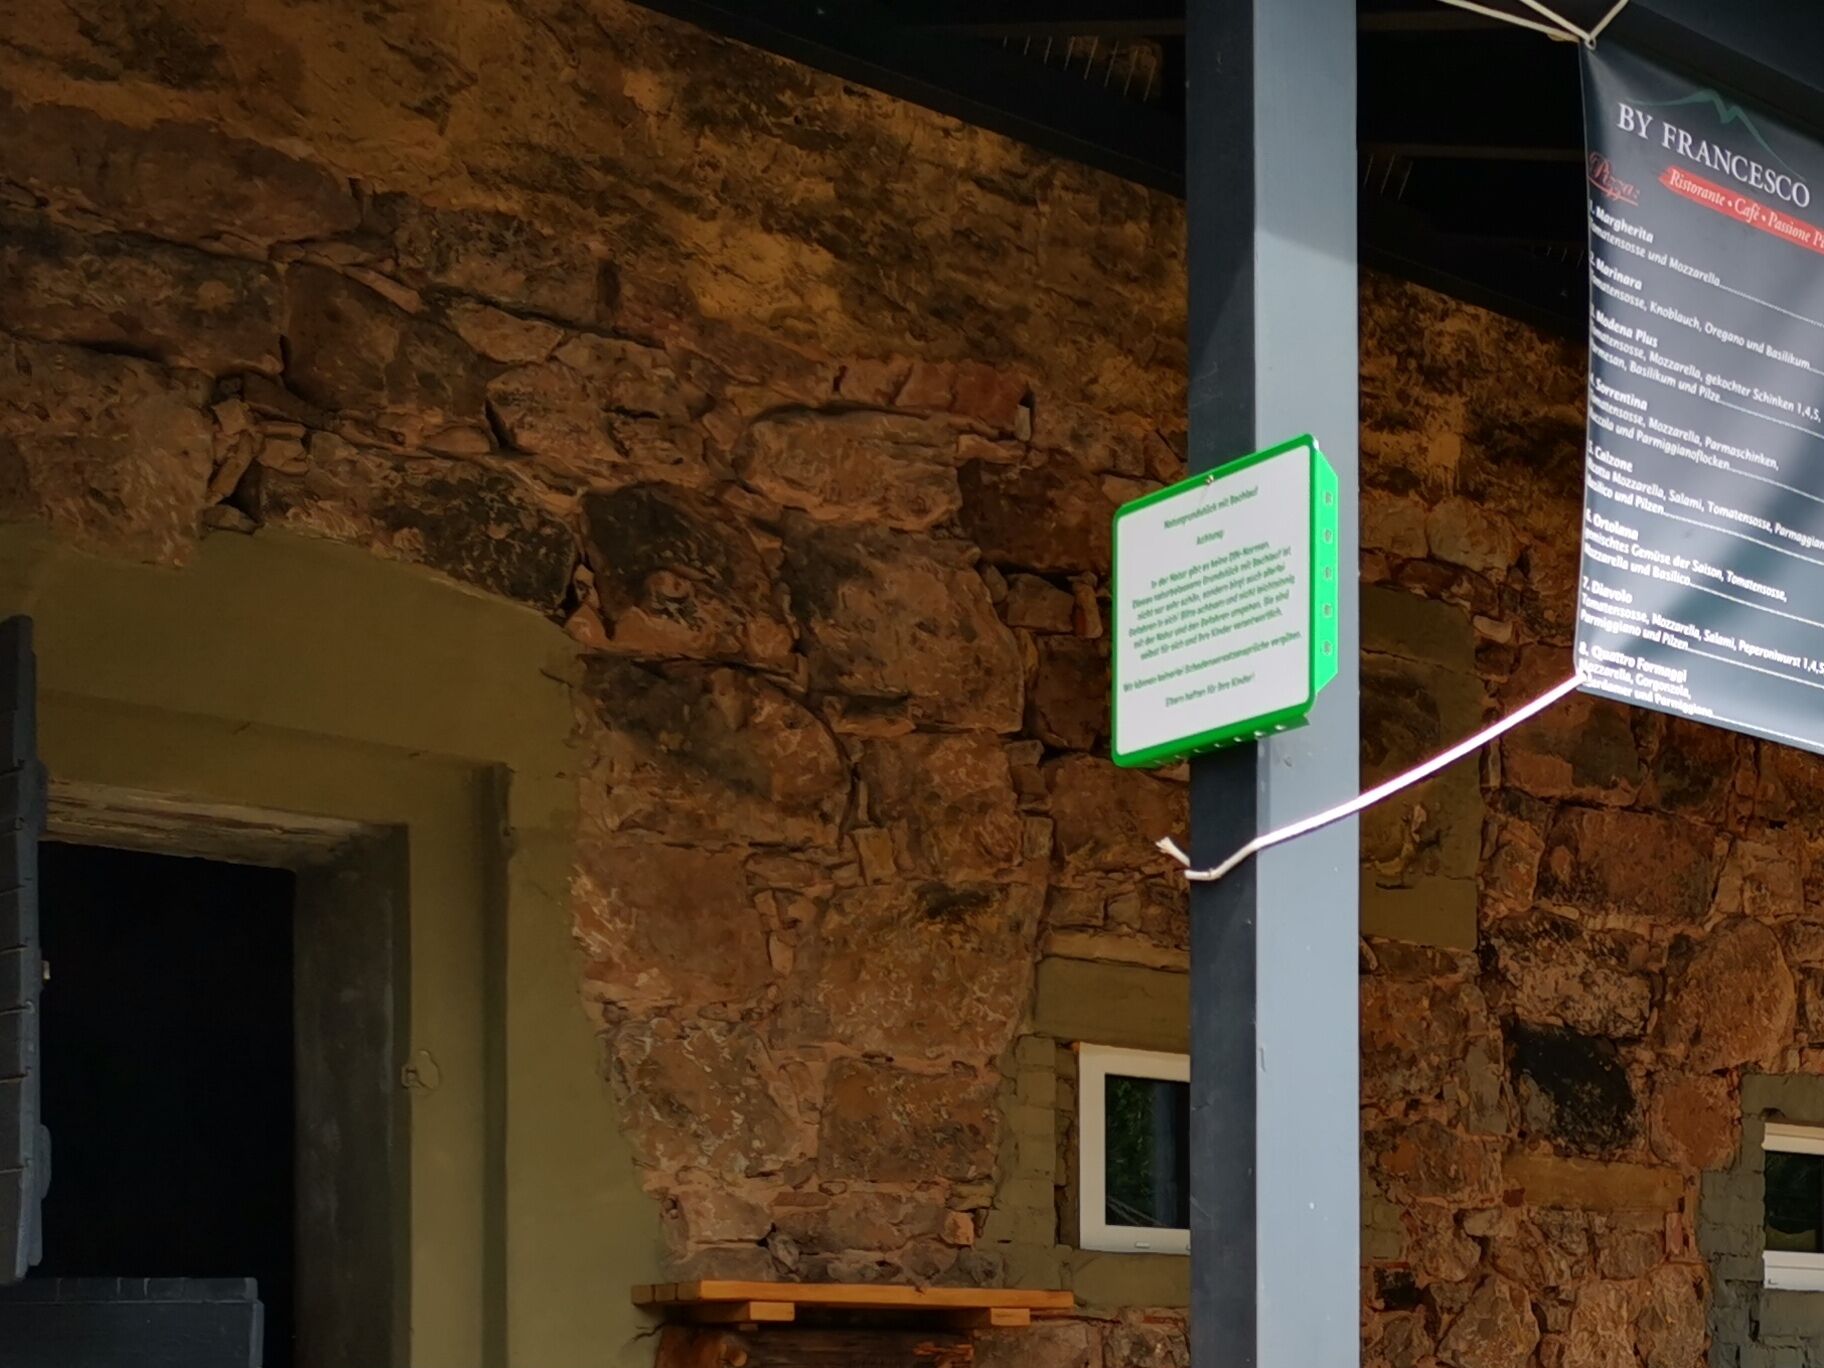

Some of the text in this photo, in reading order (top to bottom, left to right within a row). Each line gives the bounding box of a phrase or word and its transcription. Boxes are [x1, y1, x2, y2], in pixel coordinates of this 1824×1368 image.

[1617, 103, 1810, 208] BY FRANCESCO
[1669, 169, 1725, 206] Ristorante
[1768, 211, 1811, 243] Passione
[1597, 208, 1653, 243] Margherita
[1597, 259, 1642, 290] Marinara
[1648, 251, 1667, 265] und
[1669, 257, 1720, 286] Mozzarella
[1596, 311, 1657, 347] Modena Plus
[1650, 301, 1701, 331] Knoblauch,
[1705, 322, 1745, 345] Oregano
[1746, 340, 1764, 353] und
[1766, 346, 1810, 369] Basilikum
[1597, 380, 1647, 410] Sorrentina
[1630, 361, 1676, 386] Basilikum
[1678, 381, 1697, 394] und
[1699, 385, 1720, 403] Pilze
[1649, 351, 1820, 422] Mozzarella, gekochter Schinken 1,4,5,
[1615, 425, 1634, 439] und
[1649, 417, 1778, 469] Mozzarella, Parmaschinken,
[1595, 447, 1633, 472] Calzone
[1612, 472, 1666, 500] Mozzarella,
[1669, 490, 1704, 512] Salami,
[1708, 500, 1772, 532] Tomatensosse,
[1615, 491, 1633, 505] und
[1635, 495, 1664, 515] Pilzen
[1593, 514, 1638, 540] Ortolana
[1583, 576, 1632, 604] 7. Diavolo
[1630, 563, 1650, 576] und
[1652, 566, 1690, 585] Basilico
